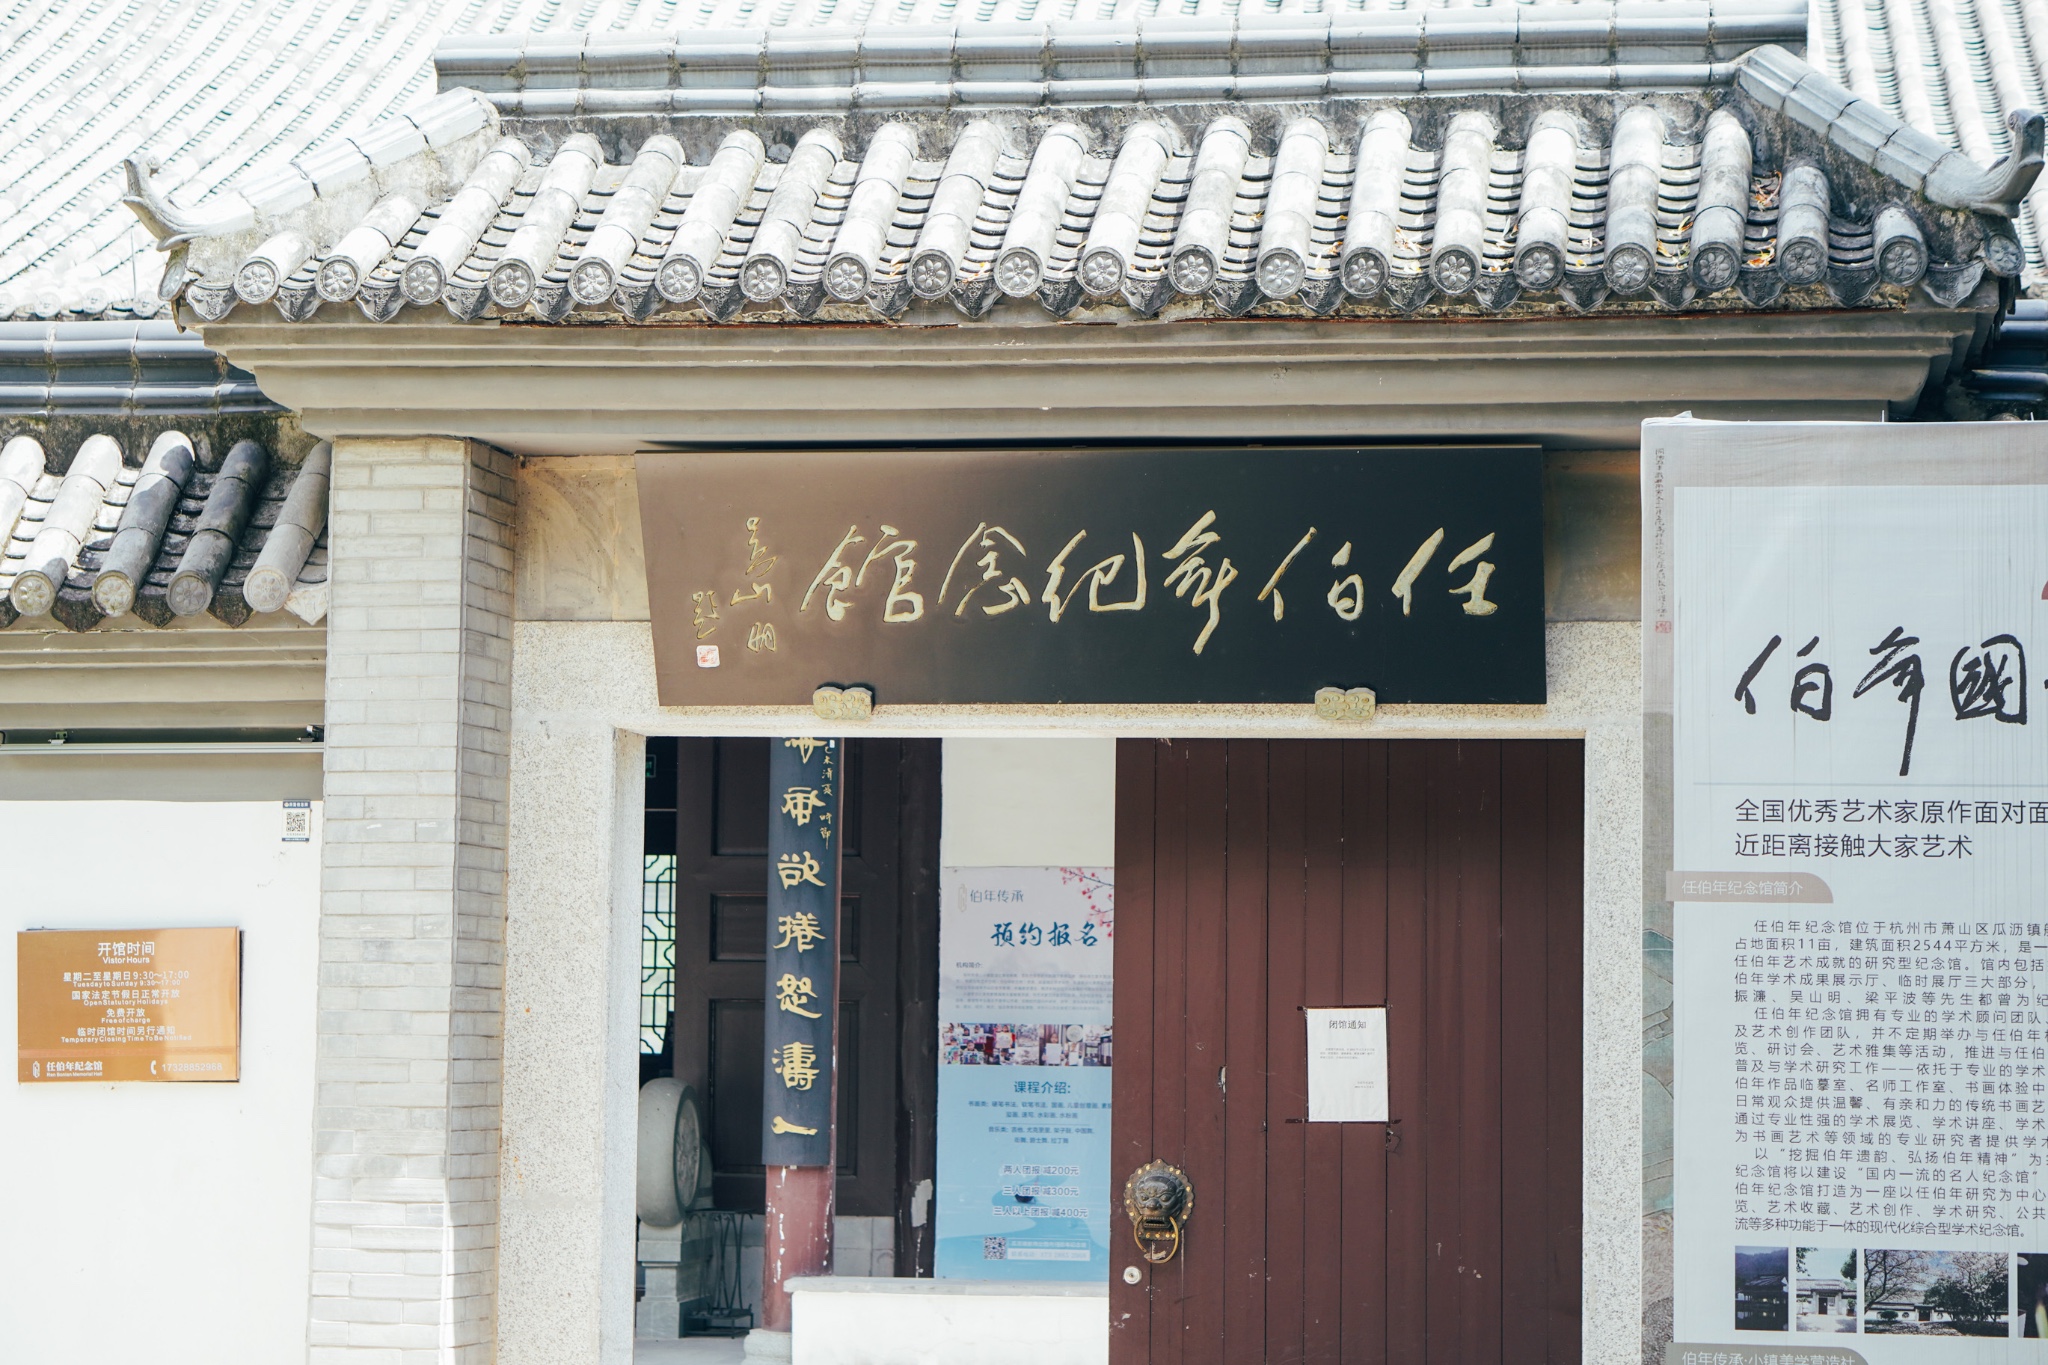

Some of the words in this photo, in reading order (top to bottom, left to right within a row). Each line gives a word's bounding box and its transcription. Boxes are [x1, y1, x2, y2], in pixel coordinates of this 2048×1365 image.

[1735, 626, 2048, 777] 伯年國
[1735, 799, 2048, 825] 全国优秀艺术家原作面对面
[1735, 832, 1973, 859] 近距离接触大家艺术
[1682, 879, 1803, 897] 任伯年纪念馆简介
[970, 889, 1024, 903] 伯年传承
[990, 921, 1098, 947] 预约报名
[97, 941, 155, 957] 开馆时间
[127, 956, 150, 964] Hours
[71, 989, 180, 1000] 国家法定节假日正常开放
[106, 1008, 145, 1018] 免费开放
[77, 1026, 176, 1037] 临时闭馆时间另行通知
[1329, 1020, 1367, 1030] 闭馆通知
[46, 1061, 103, 1072] 任伯年纪念馆
